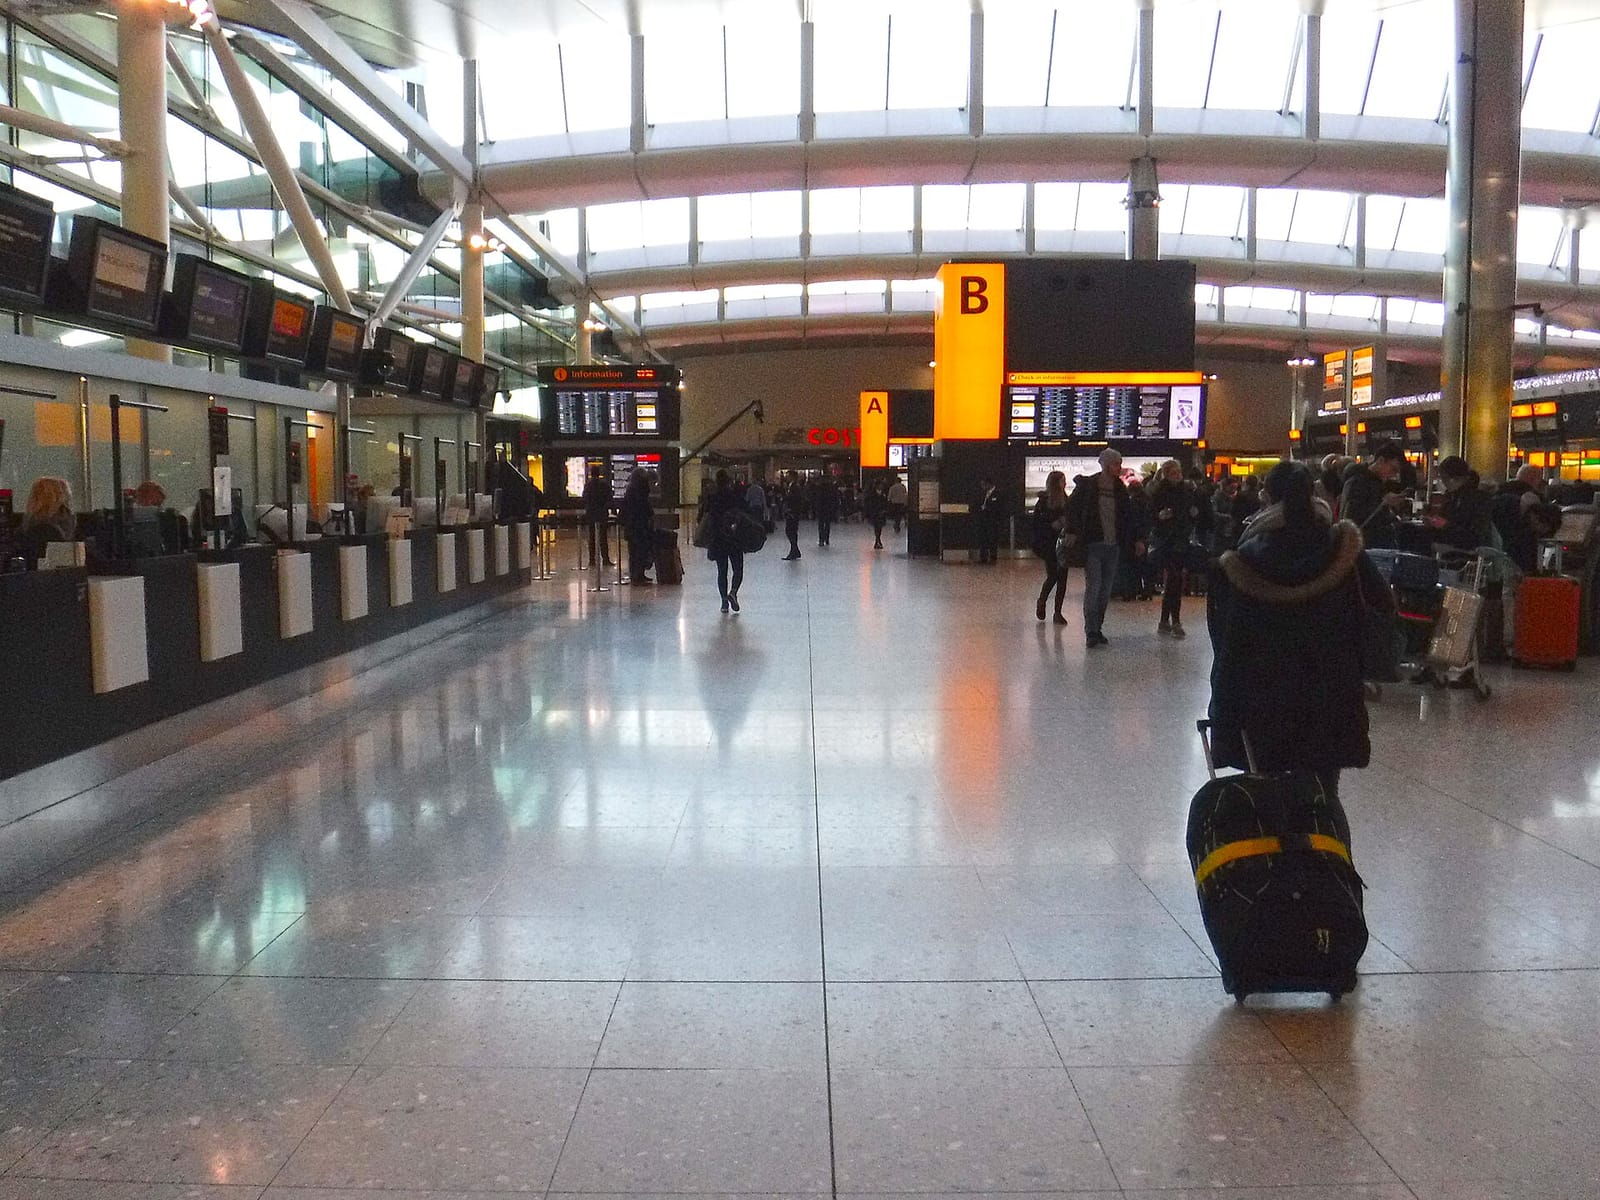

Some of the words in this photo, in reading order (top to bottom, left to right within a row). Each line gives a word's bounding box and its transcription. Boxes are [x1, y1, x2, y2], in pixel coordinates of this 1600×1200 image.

[960, 276, 989, 315] B
[571, 369, 624, 378] Information
[867, 397, 882, 414] A
